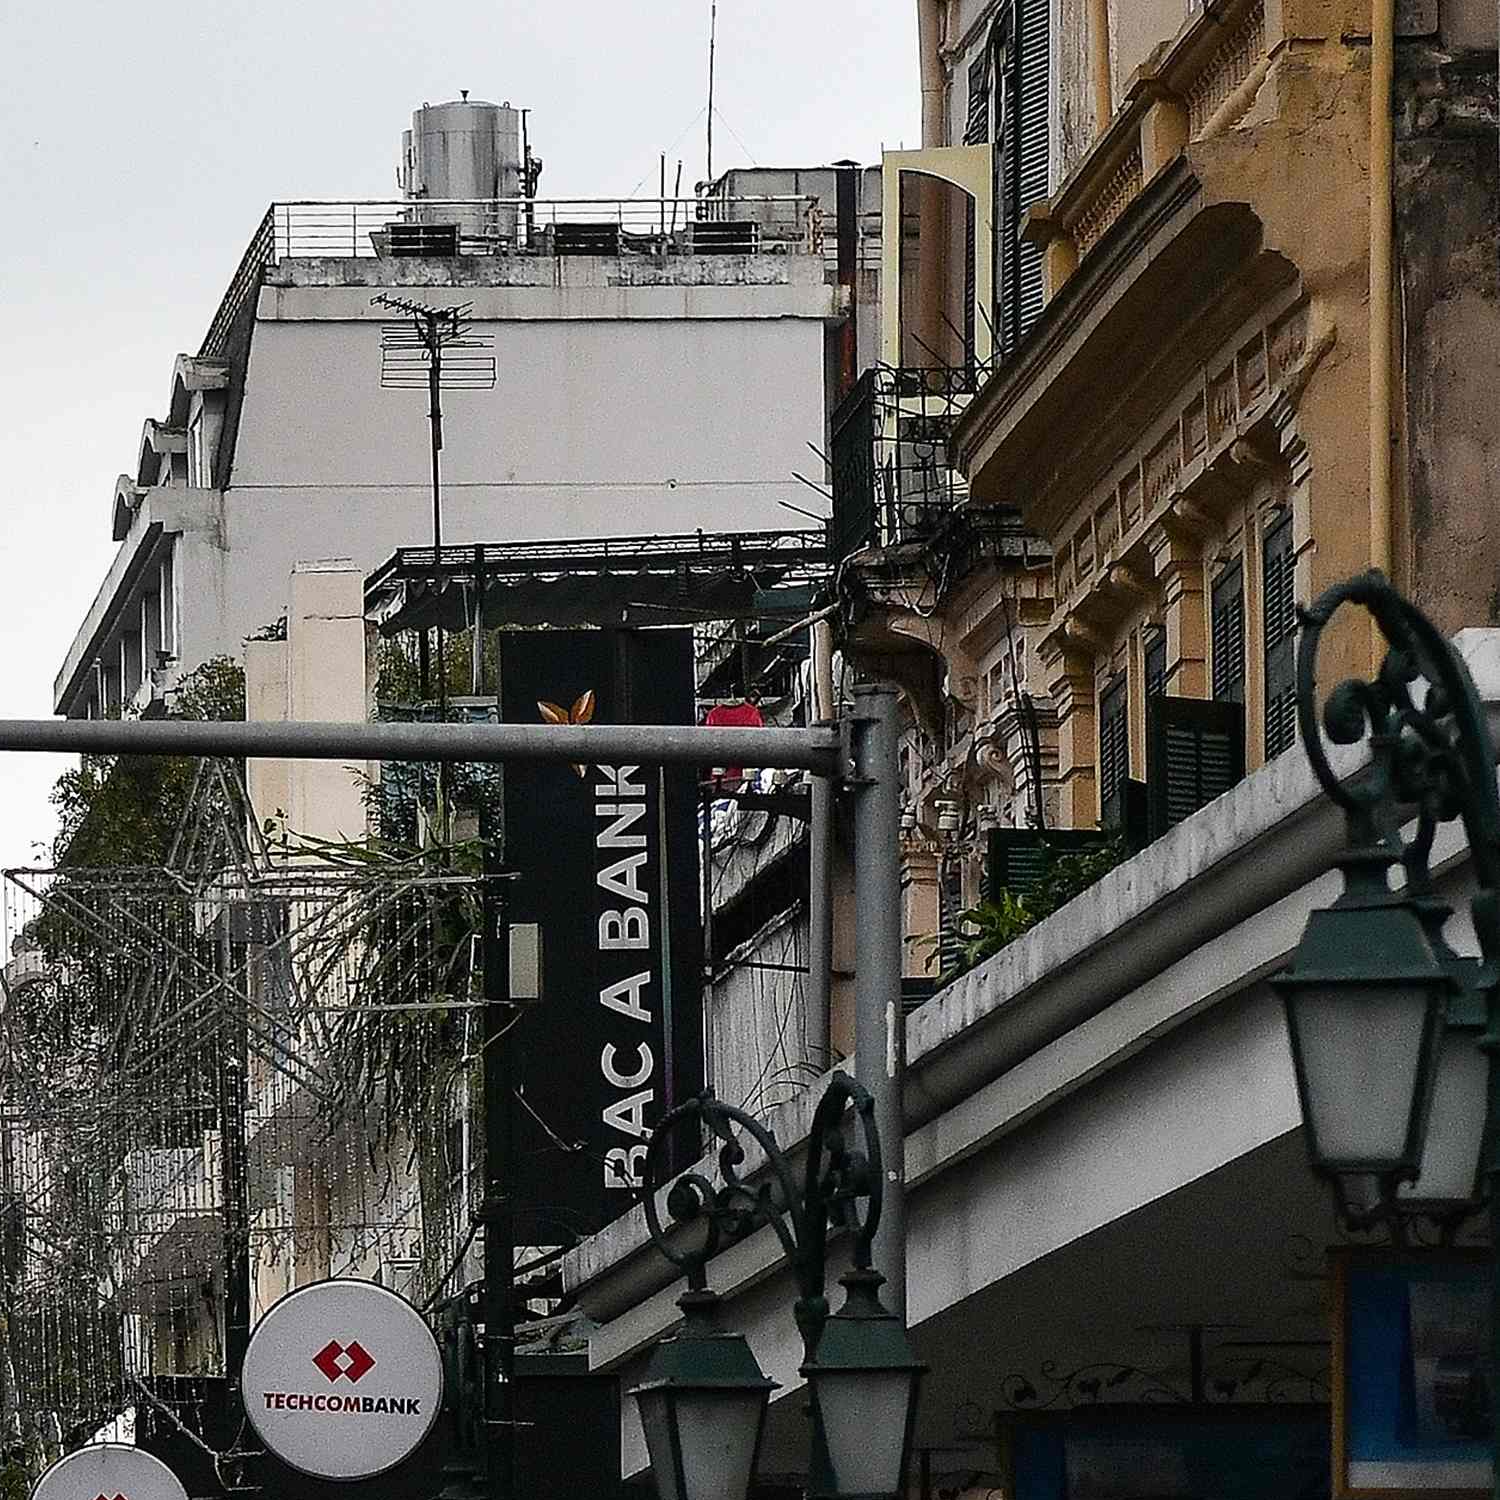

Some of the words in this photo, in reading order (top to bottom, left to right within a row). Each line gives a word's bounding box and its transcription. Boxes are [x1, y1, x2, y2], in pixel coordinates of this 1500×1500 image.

[595, 764, 651, 950] BANK
[599, 970, 652, 1023] A
[602, 1041, 655, 1190] BAC
[262, 1392, 421, 1415] TECHCOMBANK
